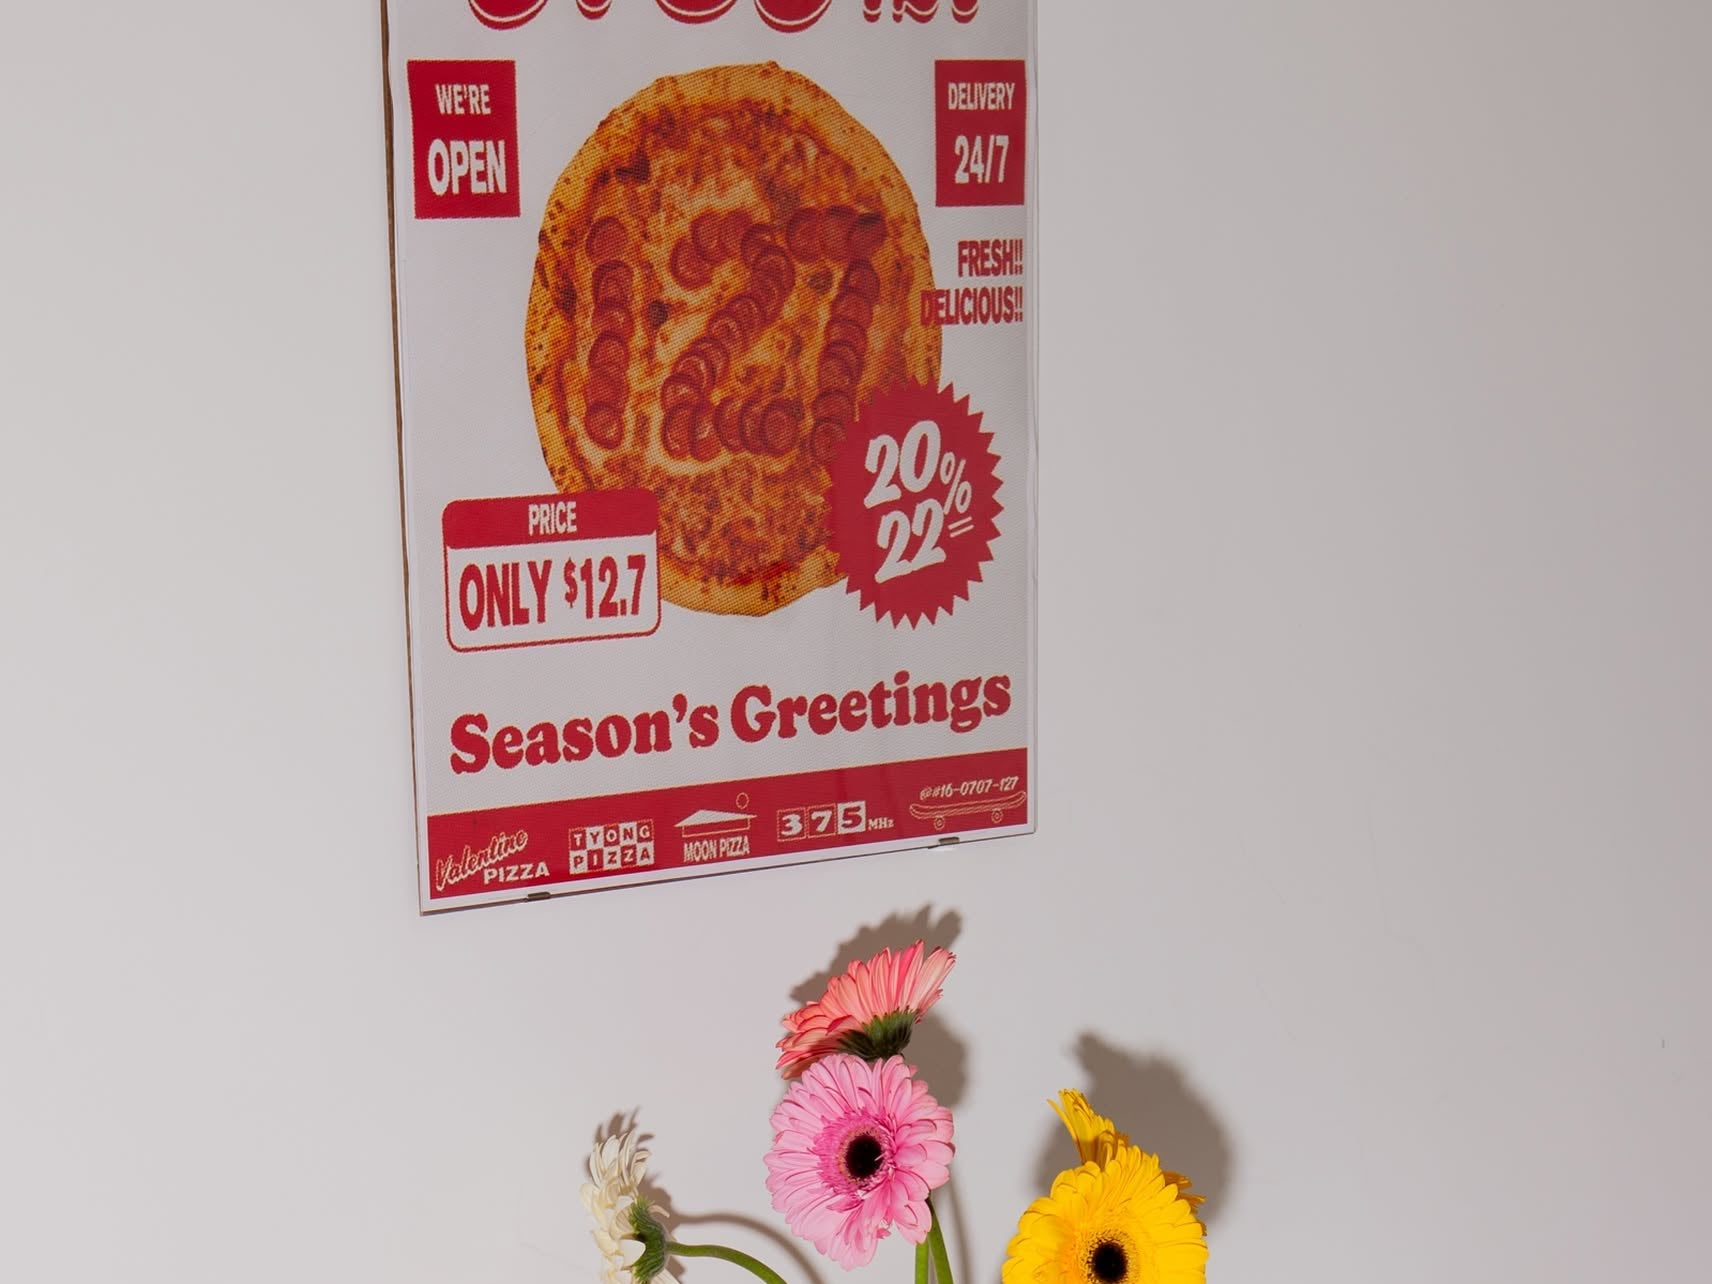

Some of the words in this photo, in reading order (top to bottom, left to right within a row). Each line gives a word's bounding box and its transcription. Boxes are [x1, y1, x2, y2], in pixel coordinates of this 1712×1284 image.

[434, 82, 490, 116] WE'RE
[947, 81, 1015, 111] DELIVERY
[427, 138, 506, 196] OPEN
[954, 135, 1009, 184] 24/7
[957, 239, 1023, 279] FRESH!!
[920, 287, 1024, 326] DELICIOUS!!
[527, 501, 577, 537] PRICE
[874, 500, 946, 584] 22
[458, 559, 552, 633] ONLY
[564, 554, 647, 619] $12.7
[450, 694, 719, 774] Season's
[730, 670, 1012, 743] Greetings
[570, 823, 651, 849] TYONG
[780, 804, 863, 836] 375
[571, 851, 652, 872] PIZZA
[683, 842, 718, 863] MOON
[719, 836, 750, 858] PIZZA
[483, 861, 550, 885] PIZZA
